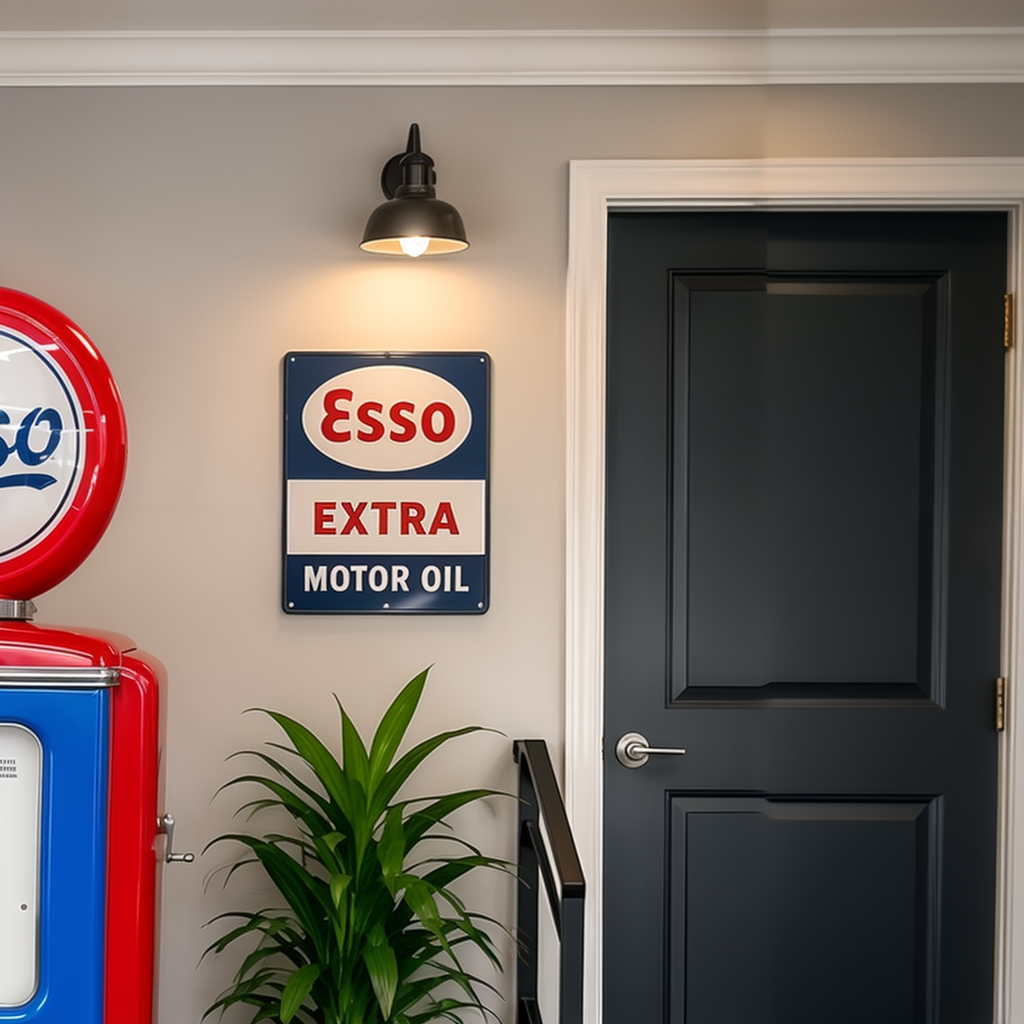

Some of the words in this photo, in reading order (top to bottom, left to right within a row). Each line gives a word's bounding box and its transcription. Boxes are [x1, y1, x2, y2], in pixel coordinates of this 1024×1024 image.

[313, 501, 460, 536] EXTRA
[303, 565, 410, 592] MOTOR
[420, 565, 469, 592] OIL
